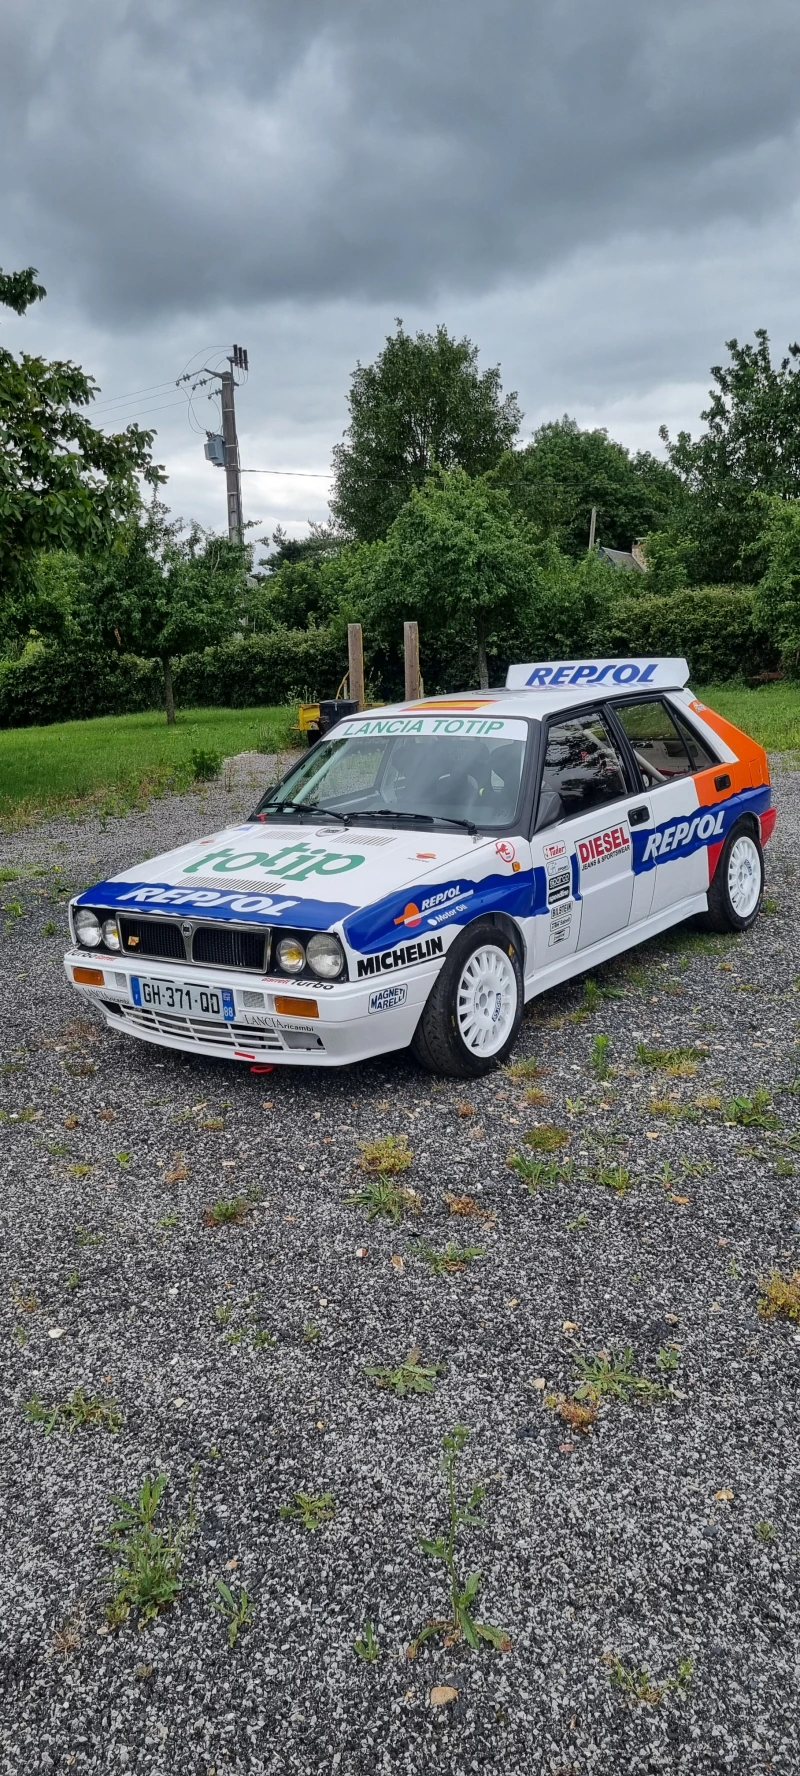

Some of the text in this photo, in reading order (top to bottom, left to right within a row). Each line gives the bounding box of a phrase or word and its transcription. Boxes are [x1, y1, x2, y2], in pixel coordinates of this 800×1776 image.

[525, 664, 658, 687] REPSOL
[343, 719, 505, 735] LANCIA TOTIP
[578, 827, 630, 864] DIESEL
[642, 811, 725, 862] REPSOL
[183, 842, 366, 881] totip
[581, 845, 631, 871] JEANS & SPORTSWEAR
[115, 887, 301, 917] REPSOL
[421, 885, 461, 911] REPSOL
[435, 903, 468, 923] Motor Oil
[357, 936, 444, 978] MICHELIN
[142, 983, 220, 1014] GH-371-QD
[223, 1006, 234, 1017] 88
